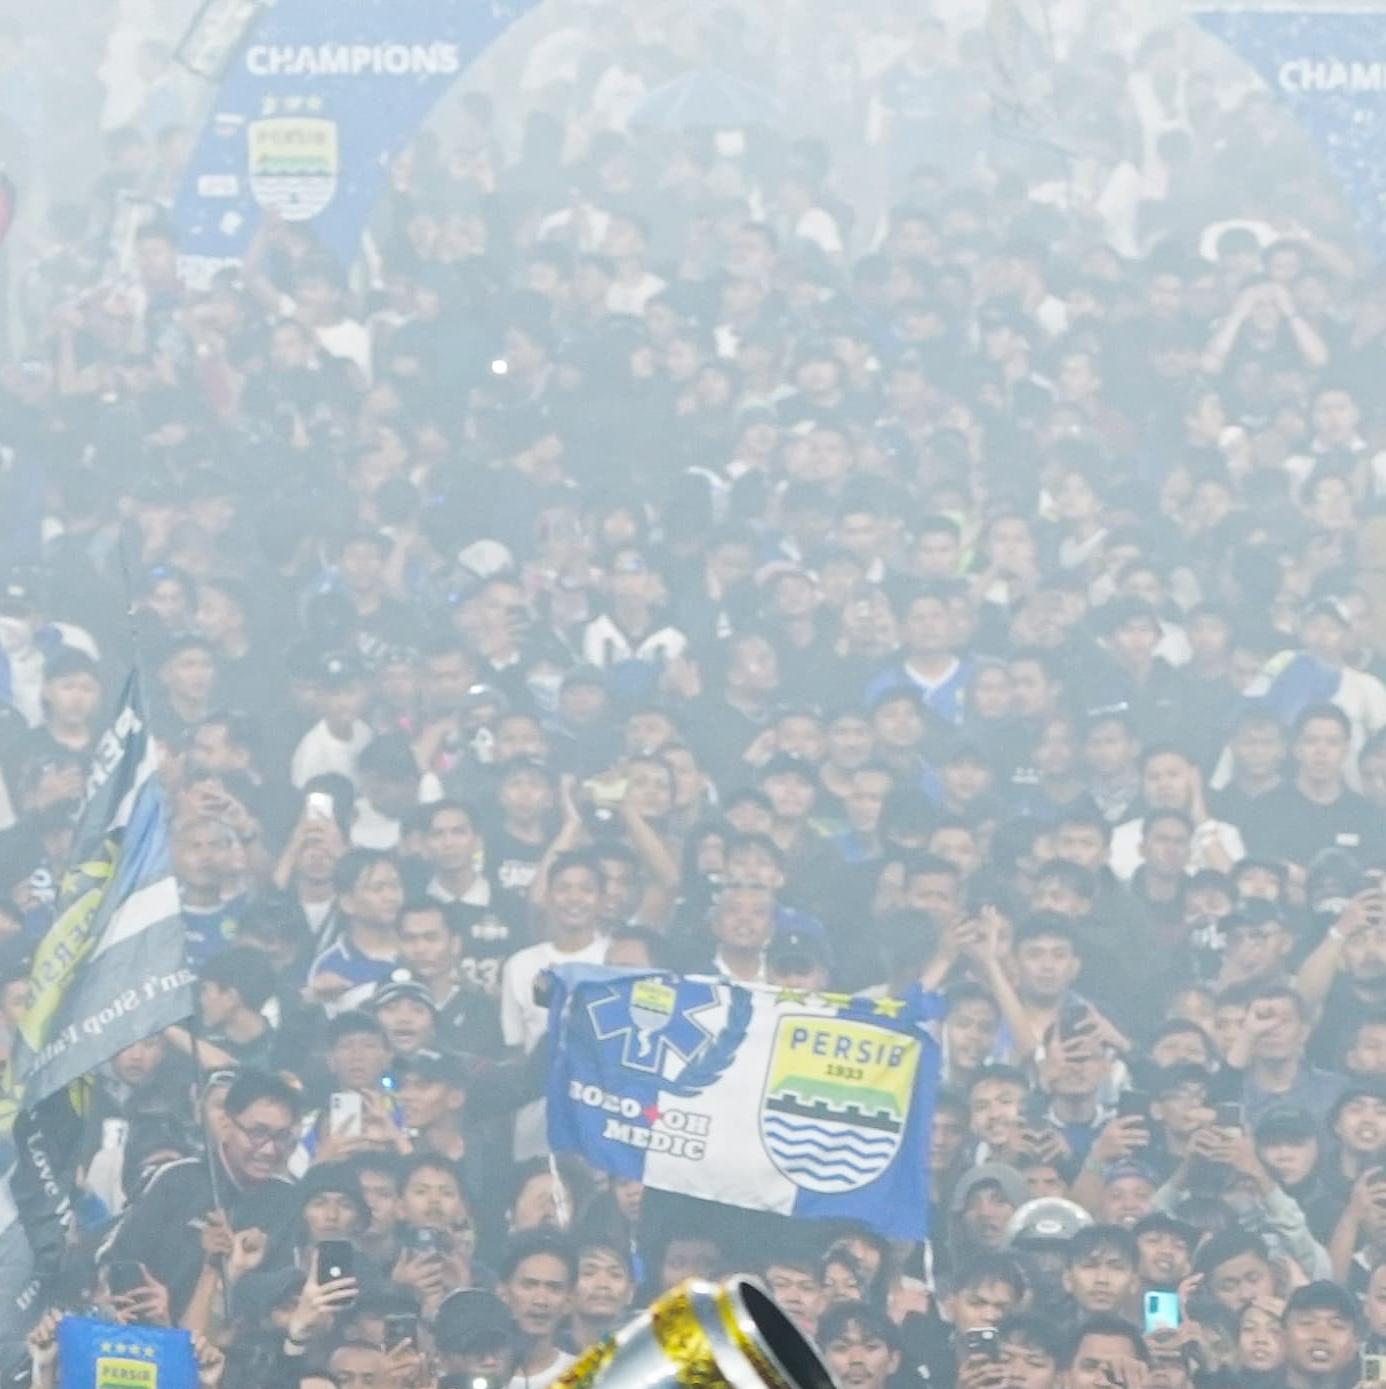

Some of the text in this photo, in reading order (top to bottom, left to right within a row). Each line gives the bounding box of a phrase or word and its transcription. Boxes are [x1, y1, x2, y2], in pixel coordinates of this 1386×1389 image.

[246, 43, 460, 76] CHAMPIONS
[791, 1026, 908, 1068] PERSIB
[823, 1063, 864, 1081] 1933
[602, 1118, 705, 1161] MEDIC
